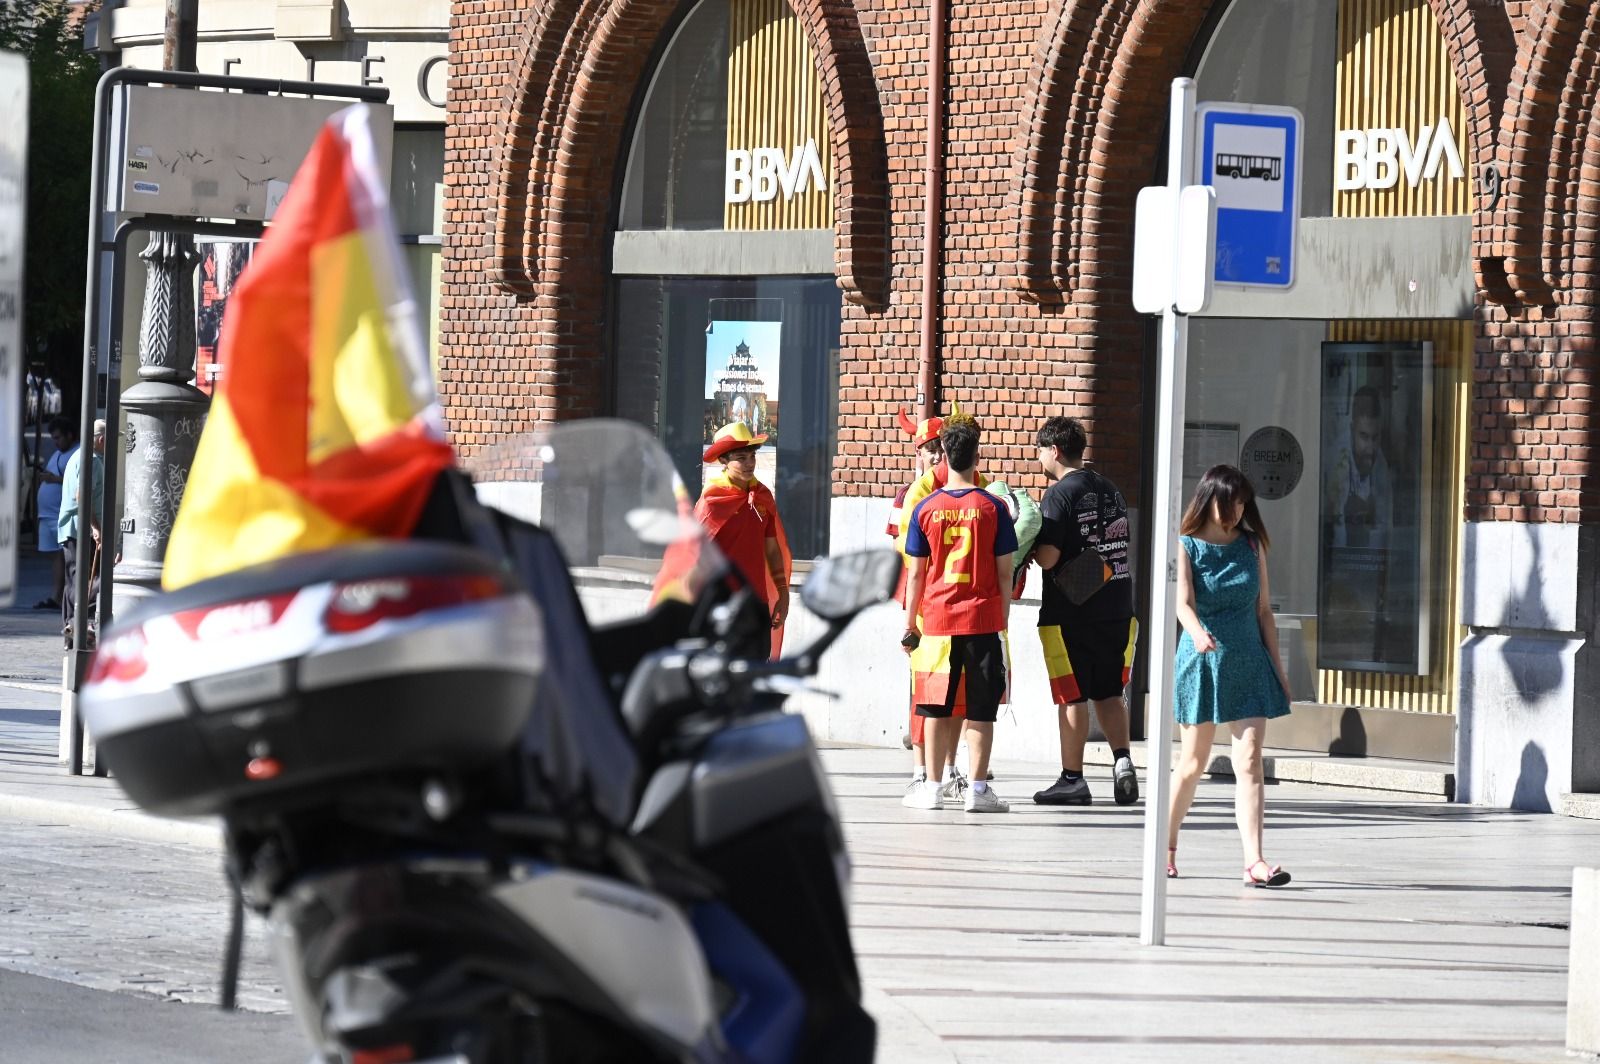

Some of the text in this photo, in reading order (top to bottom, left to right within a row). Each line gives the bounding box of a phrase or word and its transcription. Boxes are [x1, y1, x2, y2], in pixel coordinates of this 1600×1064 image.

[725, 138, 827, 203] BBVA
[1338, 116, 1465, 190] BBVA
[1482, 164, 1498, 211] 9
[1254, 450, 1291, 463] BREEAM
[944, 526, 972, 584] 2
